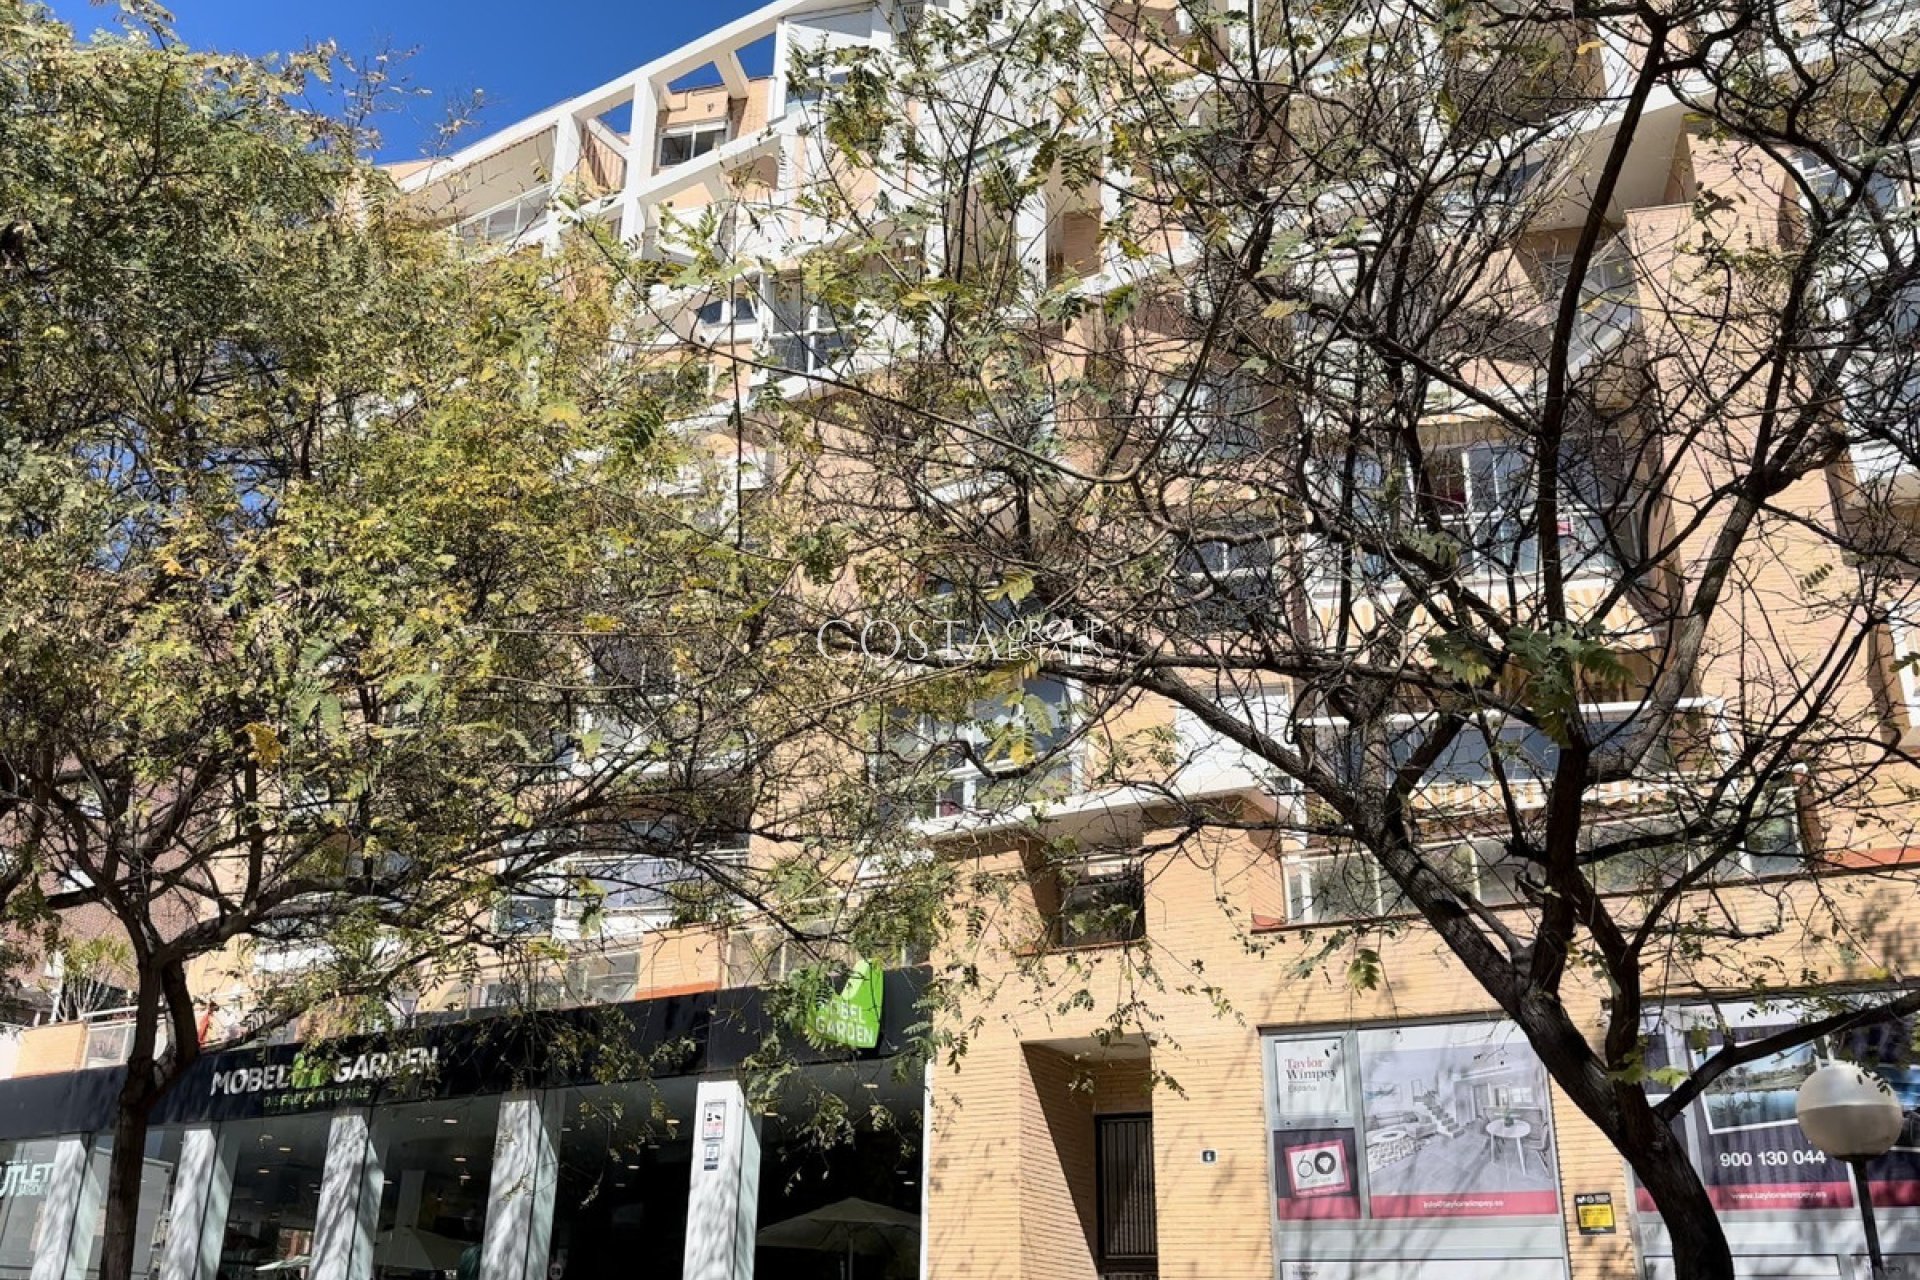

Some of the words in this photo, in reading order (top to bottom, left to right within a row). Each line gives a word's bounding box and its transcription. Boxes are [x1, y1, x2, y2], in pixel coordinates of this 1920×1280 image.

[815, 1015, 873, 1043] GARDEN
[1285, 1057, 1325, 1071] Taylor
[210, 1064, 290, 1097] MOBEL
[1286, 1069, 1337, 1083] Wimpey
[1720, 1152, 1753, 1167] 900
[1757, 1151, 1788, 1166] 130
[1792, 1149, 1827, 1165] 044
